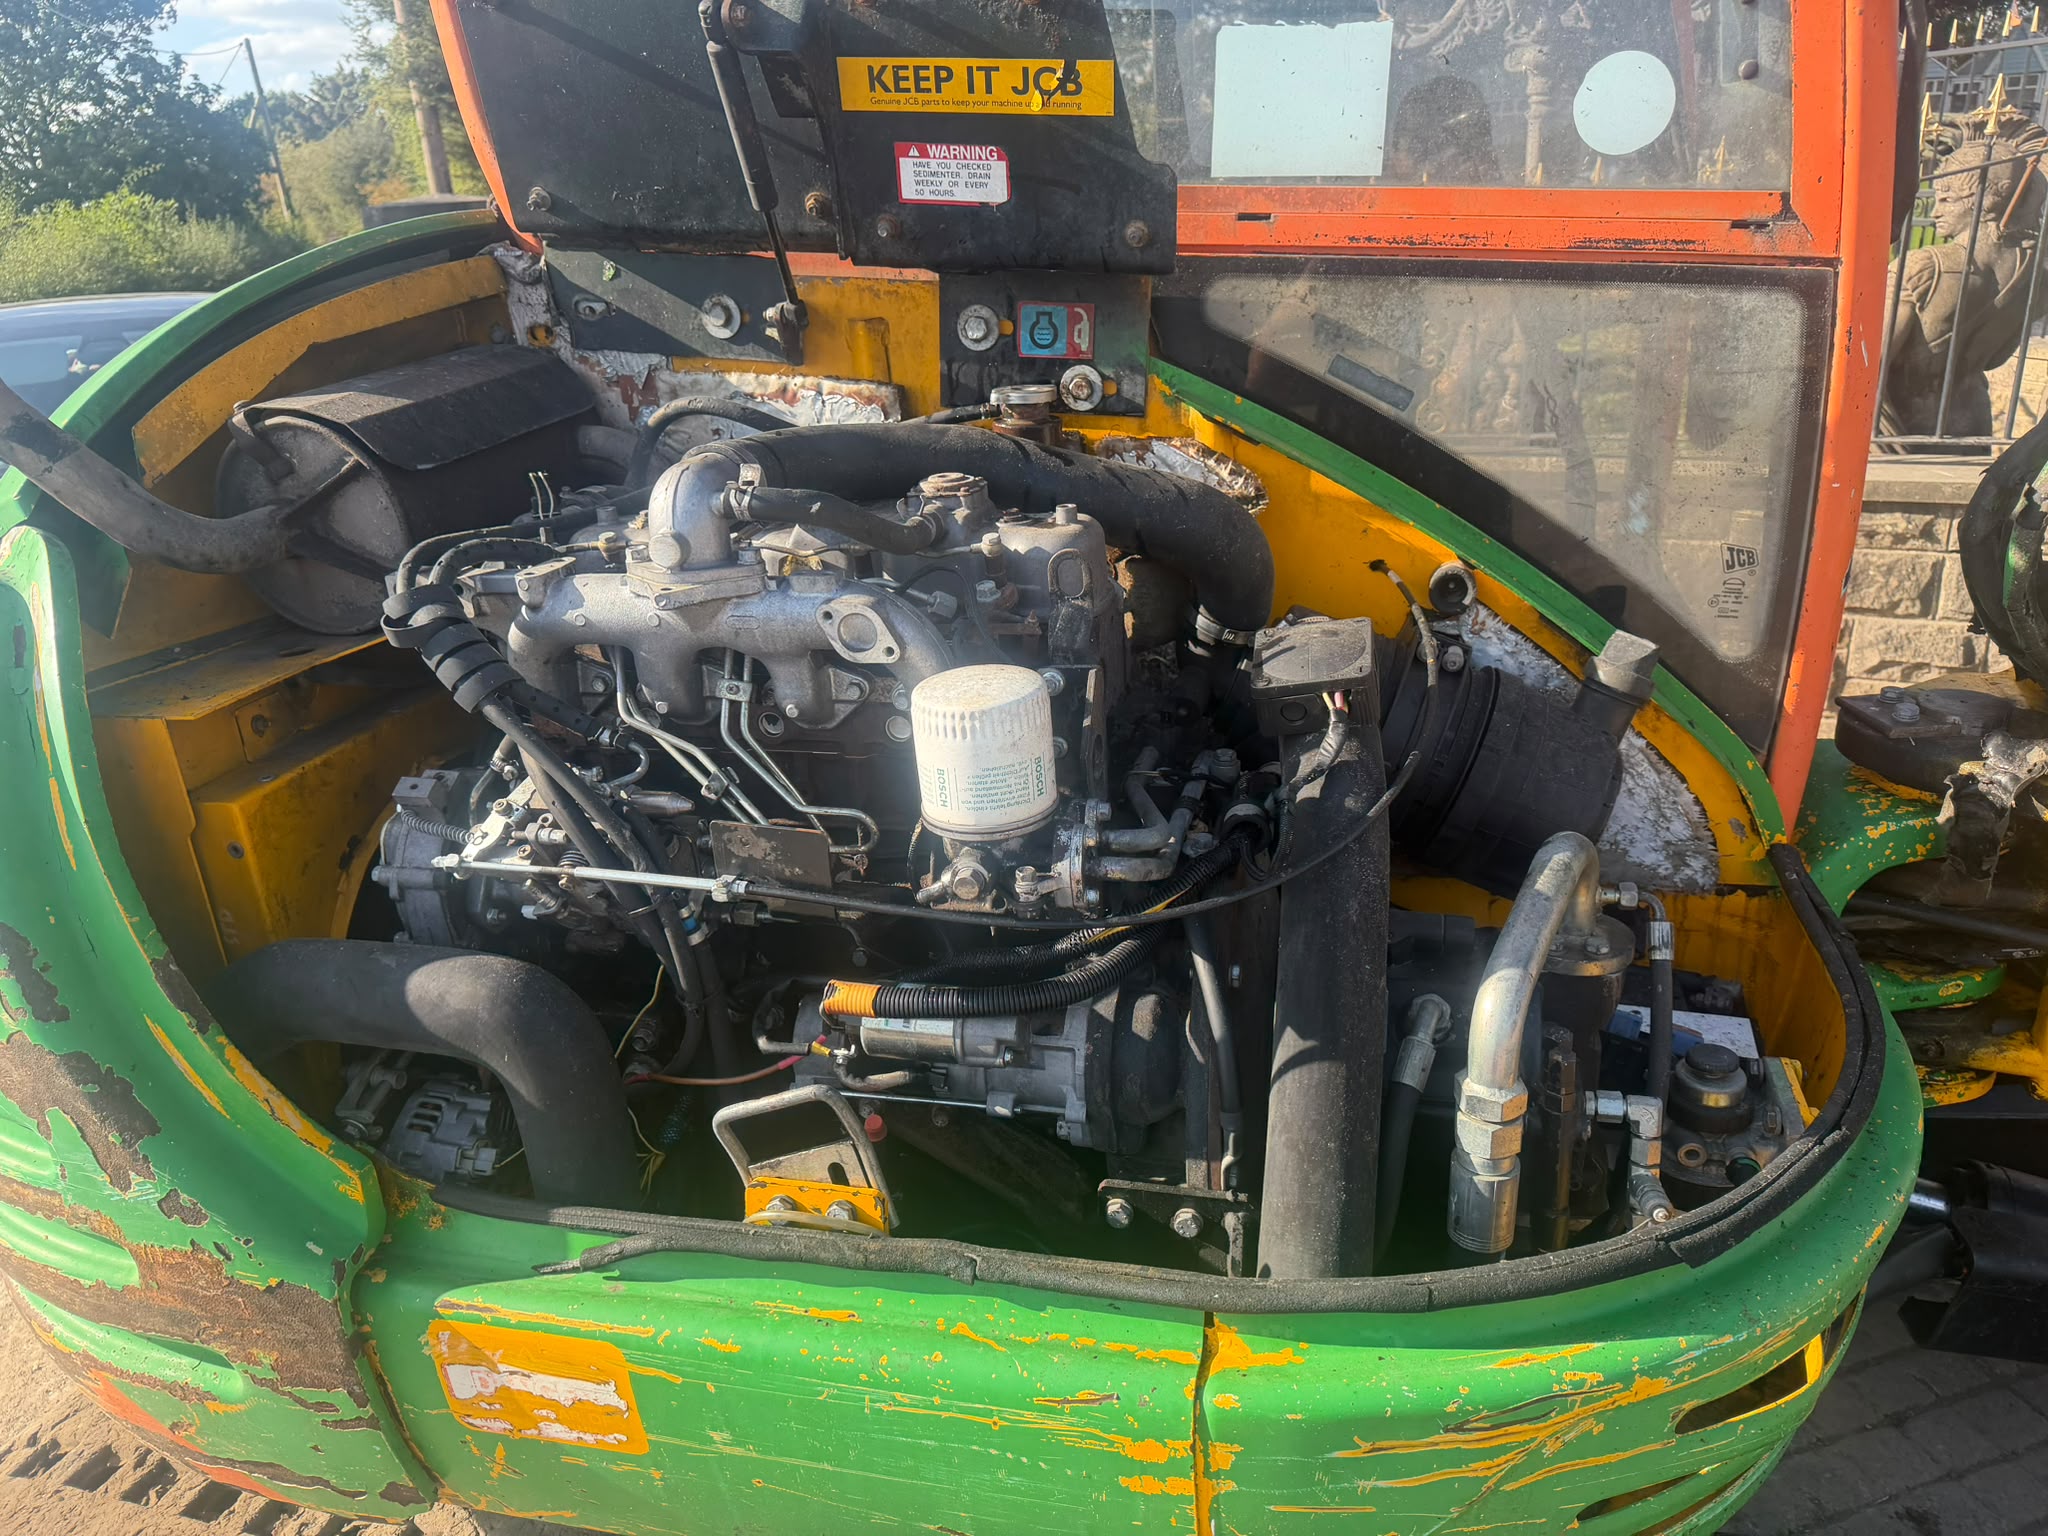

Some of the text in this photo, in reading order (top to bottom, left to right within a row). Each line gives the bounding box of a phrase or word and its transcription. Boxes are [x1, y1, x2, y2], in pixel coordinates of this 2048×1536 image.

[867, 65, 1084, 96] KEEP IT JCB
[870, 96, 901, 106] Genuine
[903, 97, 920, 106] JCB
[921, 99, 940, 107] parts
[951, 98, 970, 108] keep
[971, 100, 989, 109] your
[991, 98, 1023, 108] machine
[1052, 101, 1082, 110] running
[926, 144, 998, 160] WARNING
[913, 161, 992, 171] HAVE YOU CHECKED
[913, 170, 991, 180] SEDIMENTER. DRAIN
[914, 179, 943, 187] WEEKLY
[965, 181, 989, 189] EVERY
[929, 189, 957, 197] HOURS.
[1725, 546, 1756, 571] JCB
[1034, 756, 1045, 797] BOSCH
[937, 768, 949, 808] BOSCH
